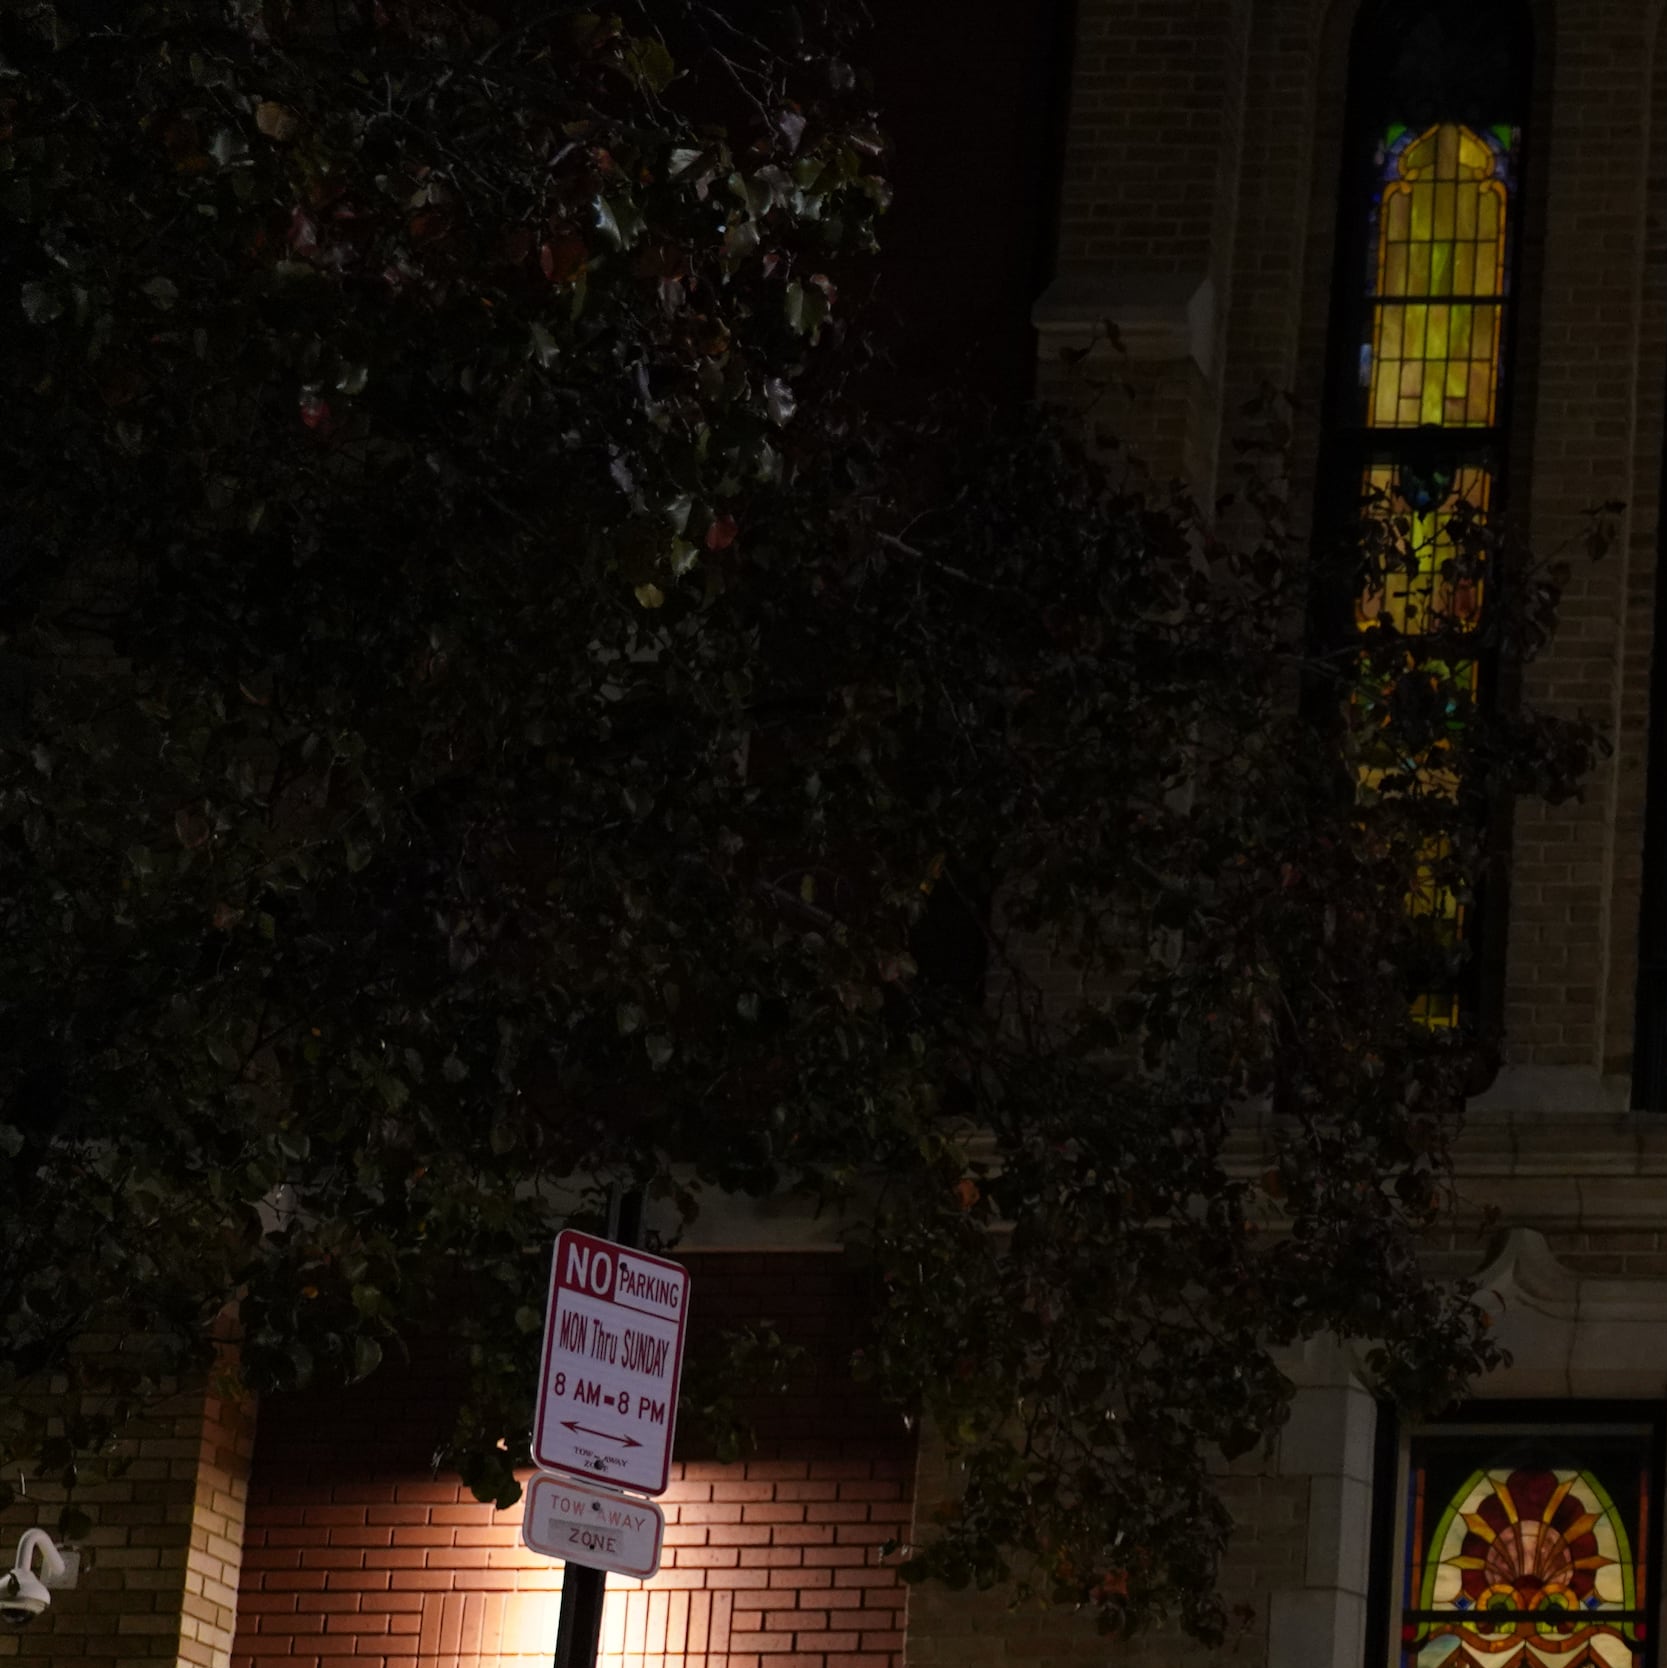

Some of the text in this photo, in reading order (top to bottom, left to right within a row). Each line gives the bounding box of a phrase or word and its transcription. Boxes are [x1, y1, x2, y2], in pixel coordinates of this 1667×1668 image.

[565, 1242, 680, 1309] NO PARKING
[559, 1309, 670, 1378] MON Thru SUNDAY
[638, 1396, 665, 1425] PM
[583, 1460, 609, 1472] ZOE
[568, 1527, 617, 1553] ZONE
